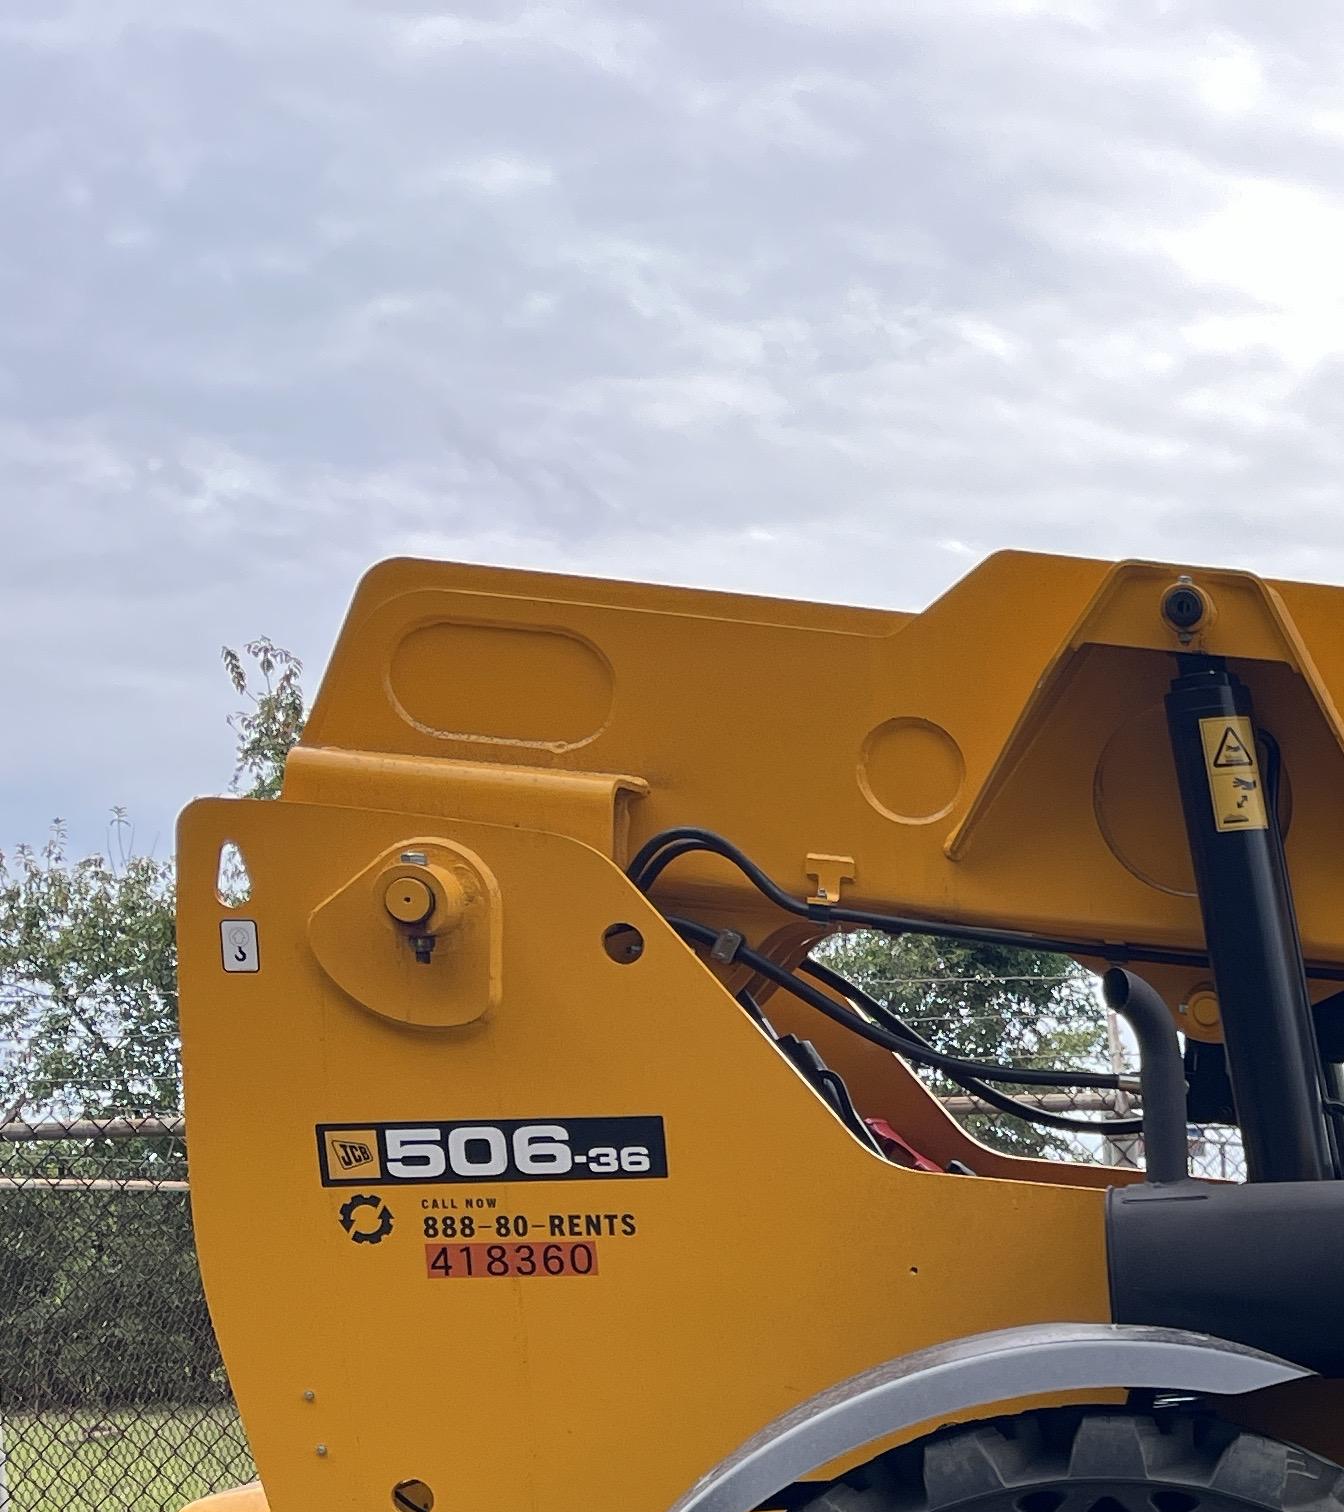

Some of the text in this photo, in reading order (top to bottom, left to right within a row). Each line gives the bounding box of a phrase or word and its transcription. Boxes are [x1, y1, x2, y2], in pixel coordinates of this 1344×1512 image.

[340, 1124, 651, 1178] JCB 506-36
[421, 1197, 497, 1210] CALL NOW
[423, 1214, 637, 1239] 888-80-RENTS
[430, 1243, 594, 1278] 418360
